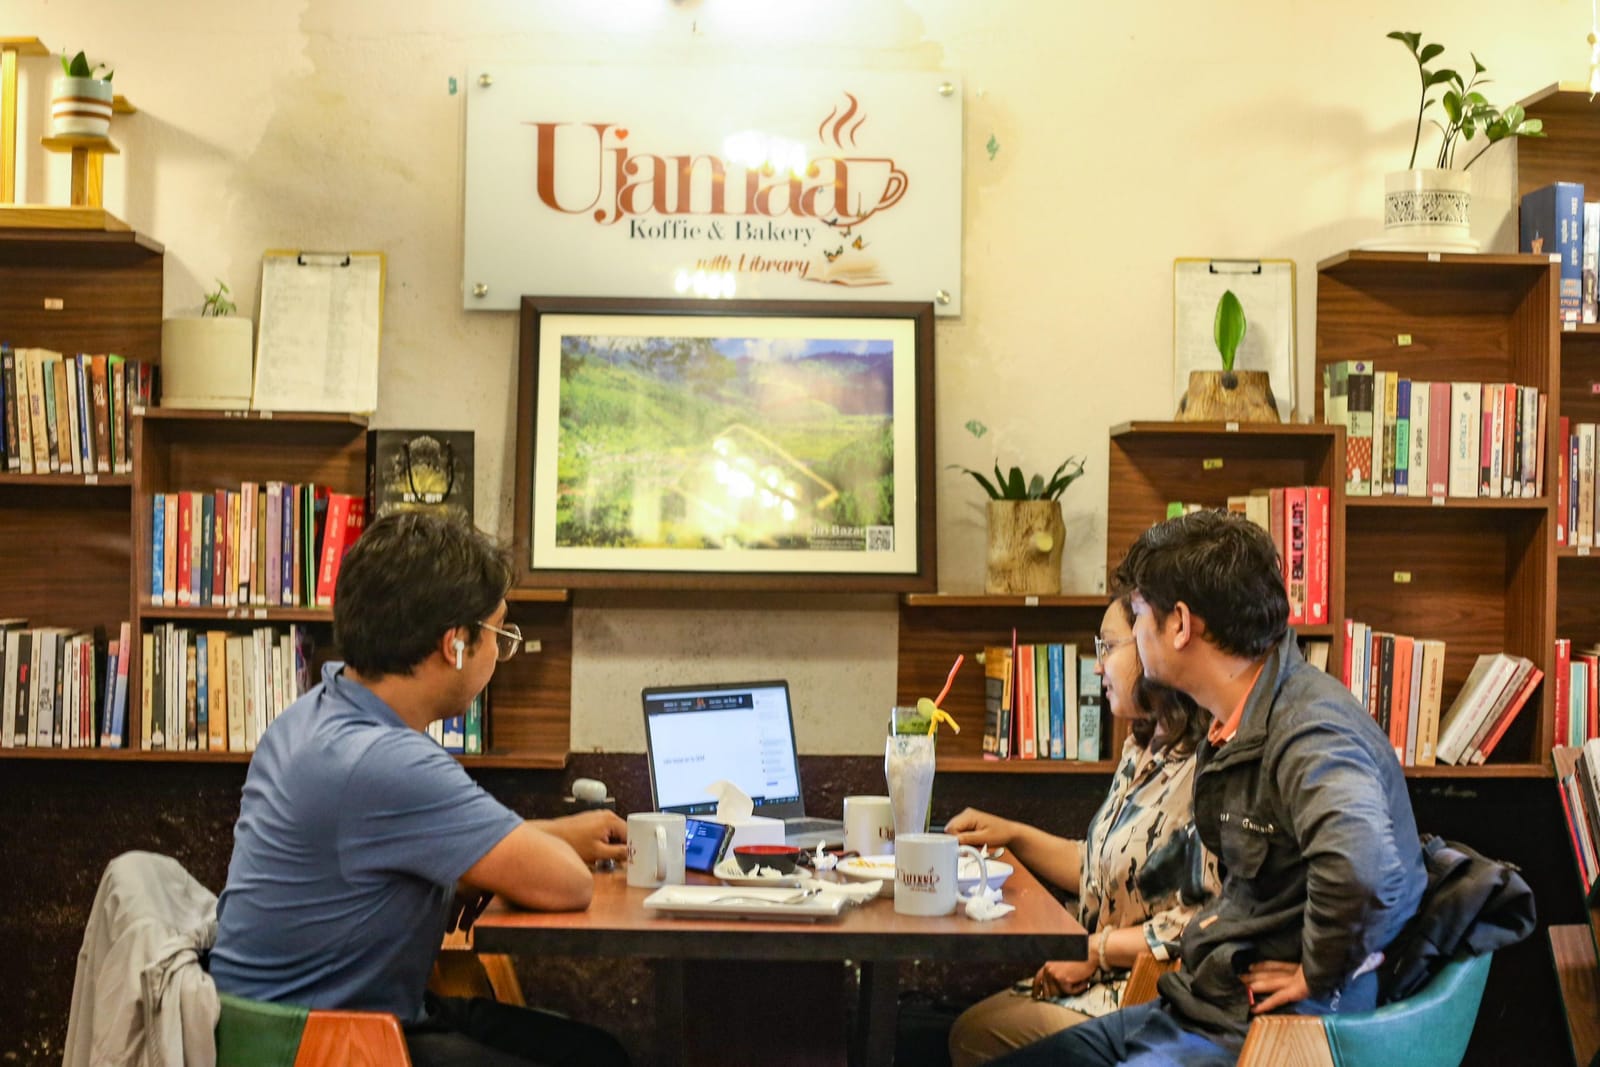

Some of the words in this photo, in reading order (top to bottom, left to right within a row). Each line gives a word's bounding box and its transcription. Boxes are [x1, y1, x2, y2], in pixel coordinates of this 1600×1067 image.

[520, 121, 856, 225] Ujamaa
[629, 218, 701, 240] Koffie
[707, 220, 725, 241] &
[735, 220, 815, 248] Bakery
[738, 253, 811, 279] Library
[831, 525, 865, 537] Bazar
